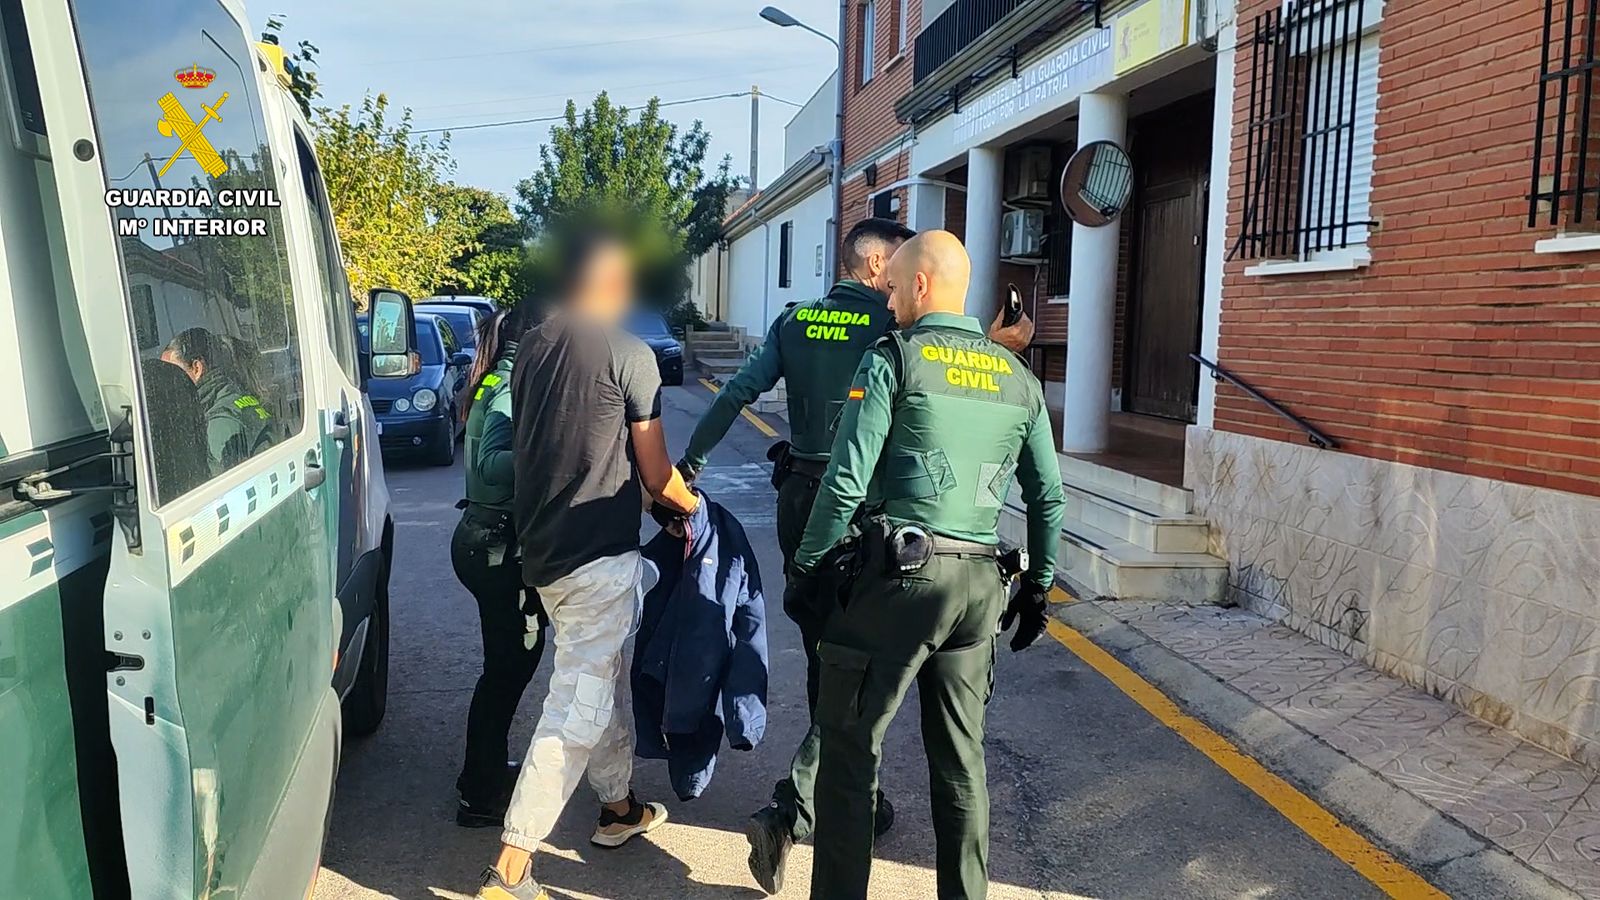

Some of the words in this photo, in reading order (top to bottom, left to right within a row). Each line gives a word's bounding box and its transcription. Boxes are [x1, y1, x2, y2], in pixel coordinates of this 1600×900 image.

[1011, 76, 1023, 97] DE
[1024, 69, 1037, 91] LA
[1038, 46, 1080, 81] GUARDIA
[1081, 28, 1110, 59] CIVIL
[1018, 91, 1030, 111] LA
[1035, 72, 1069, 101] PATRIA
[796, 308, 870, 326] GUARDIA
[806, 325, 850, 341] CIVIL
[921, 345, 1013, 375] GUARDIA
[946, 367, 1000, 392] CIVIL
